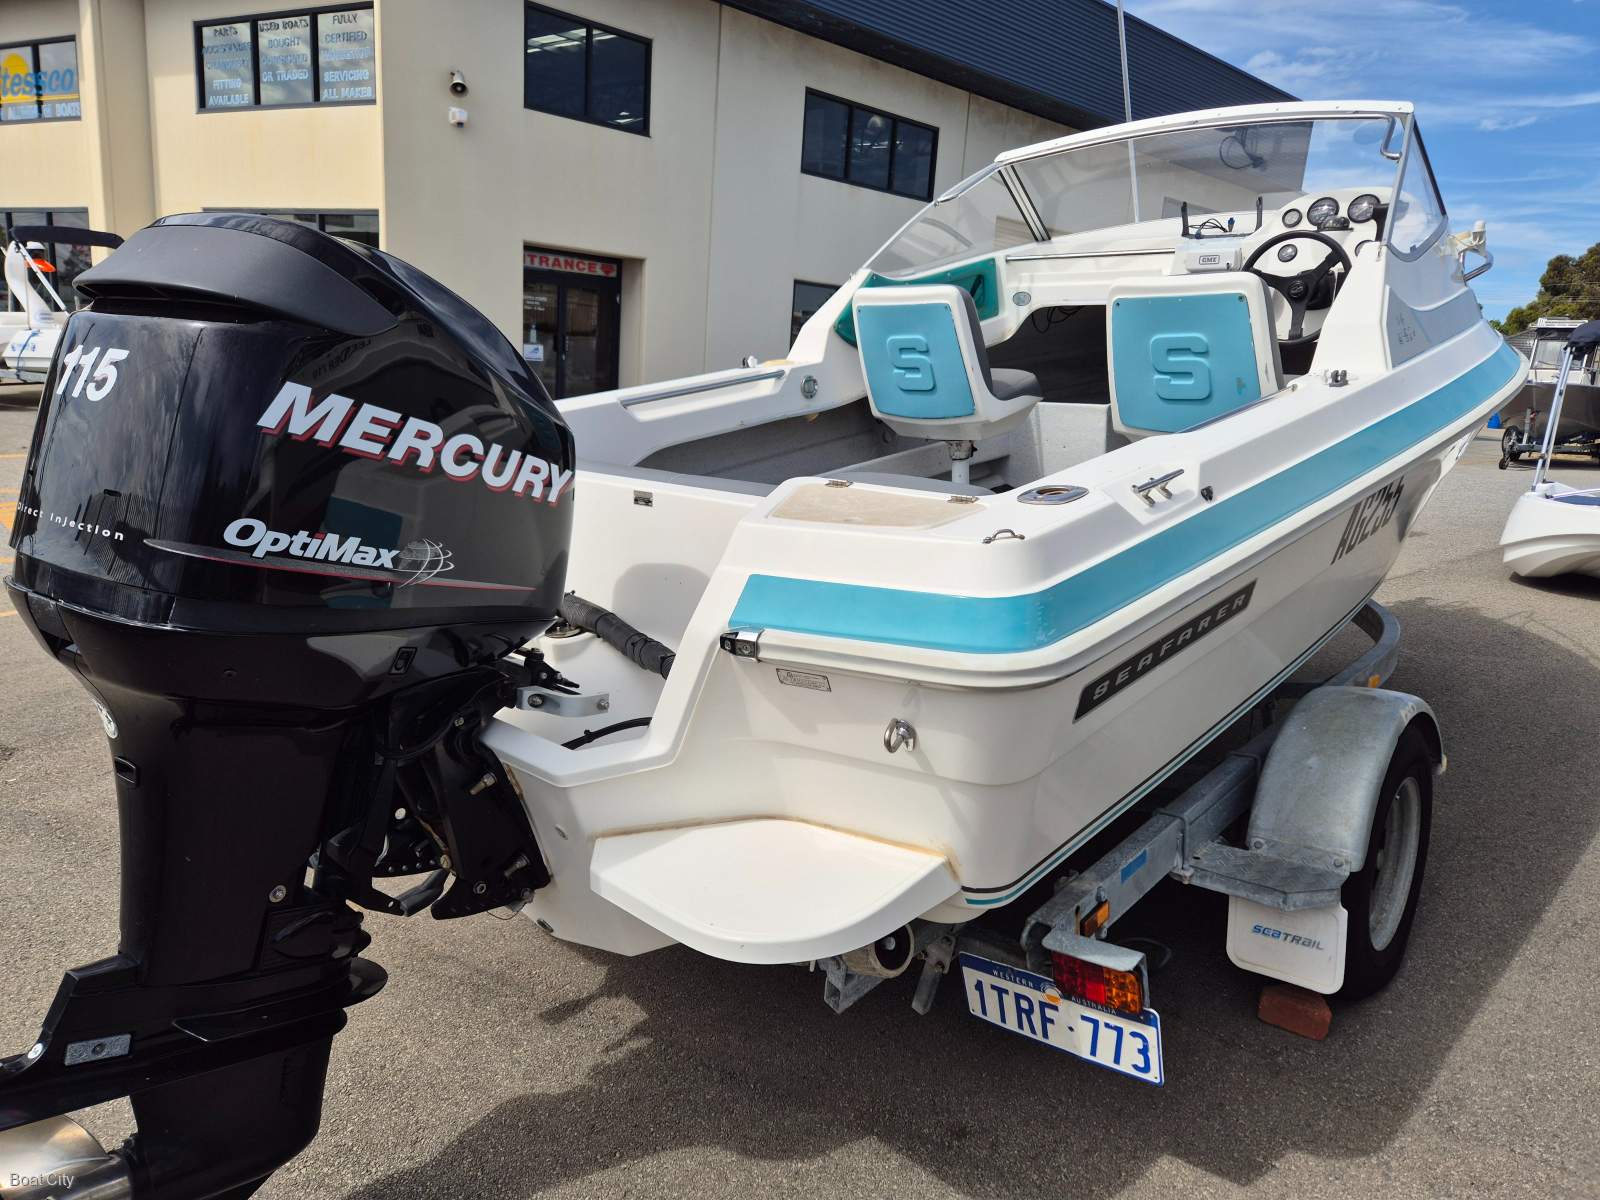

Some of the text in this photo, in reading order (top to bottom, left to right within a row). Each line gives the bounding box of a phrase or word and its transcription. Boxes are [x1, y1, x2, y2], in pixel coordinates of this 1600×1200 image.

[332, 13, 358, 25] FULLY
[267, 37, 301, 48] BOUGHT
[324, 31, 368, 43] CERTIFIED
[262, 69, 309, 82] OR TRADED
[323, 69, 370, 82] SERVICING
[213, 79, 242, 90] FITTING
[208, 94, 249, 106] AVAILABLE
[524, 252, 598, 273] TRANCE
[56, 344, 130, 401] 115
[257, 381, 574, 508] MERCURY
[50, 512, 124, 541] Injection
[223, 518, 400, 570] OptiMax
[1092, 594, 1245, 700] SEAFARER
[992, 969, 1117, 1016] WESTERN AUSTRALIA
